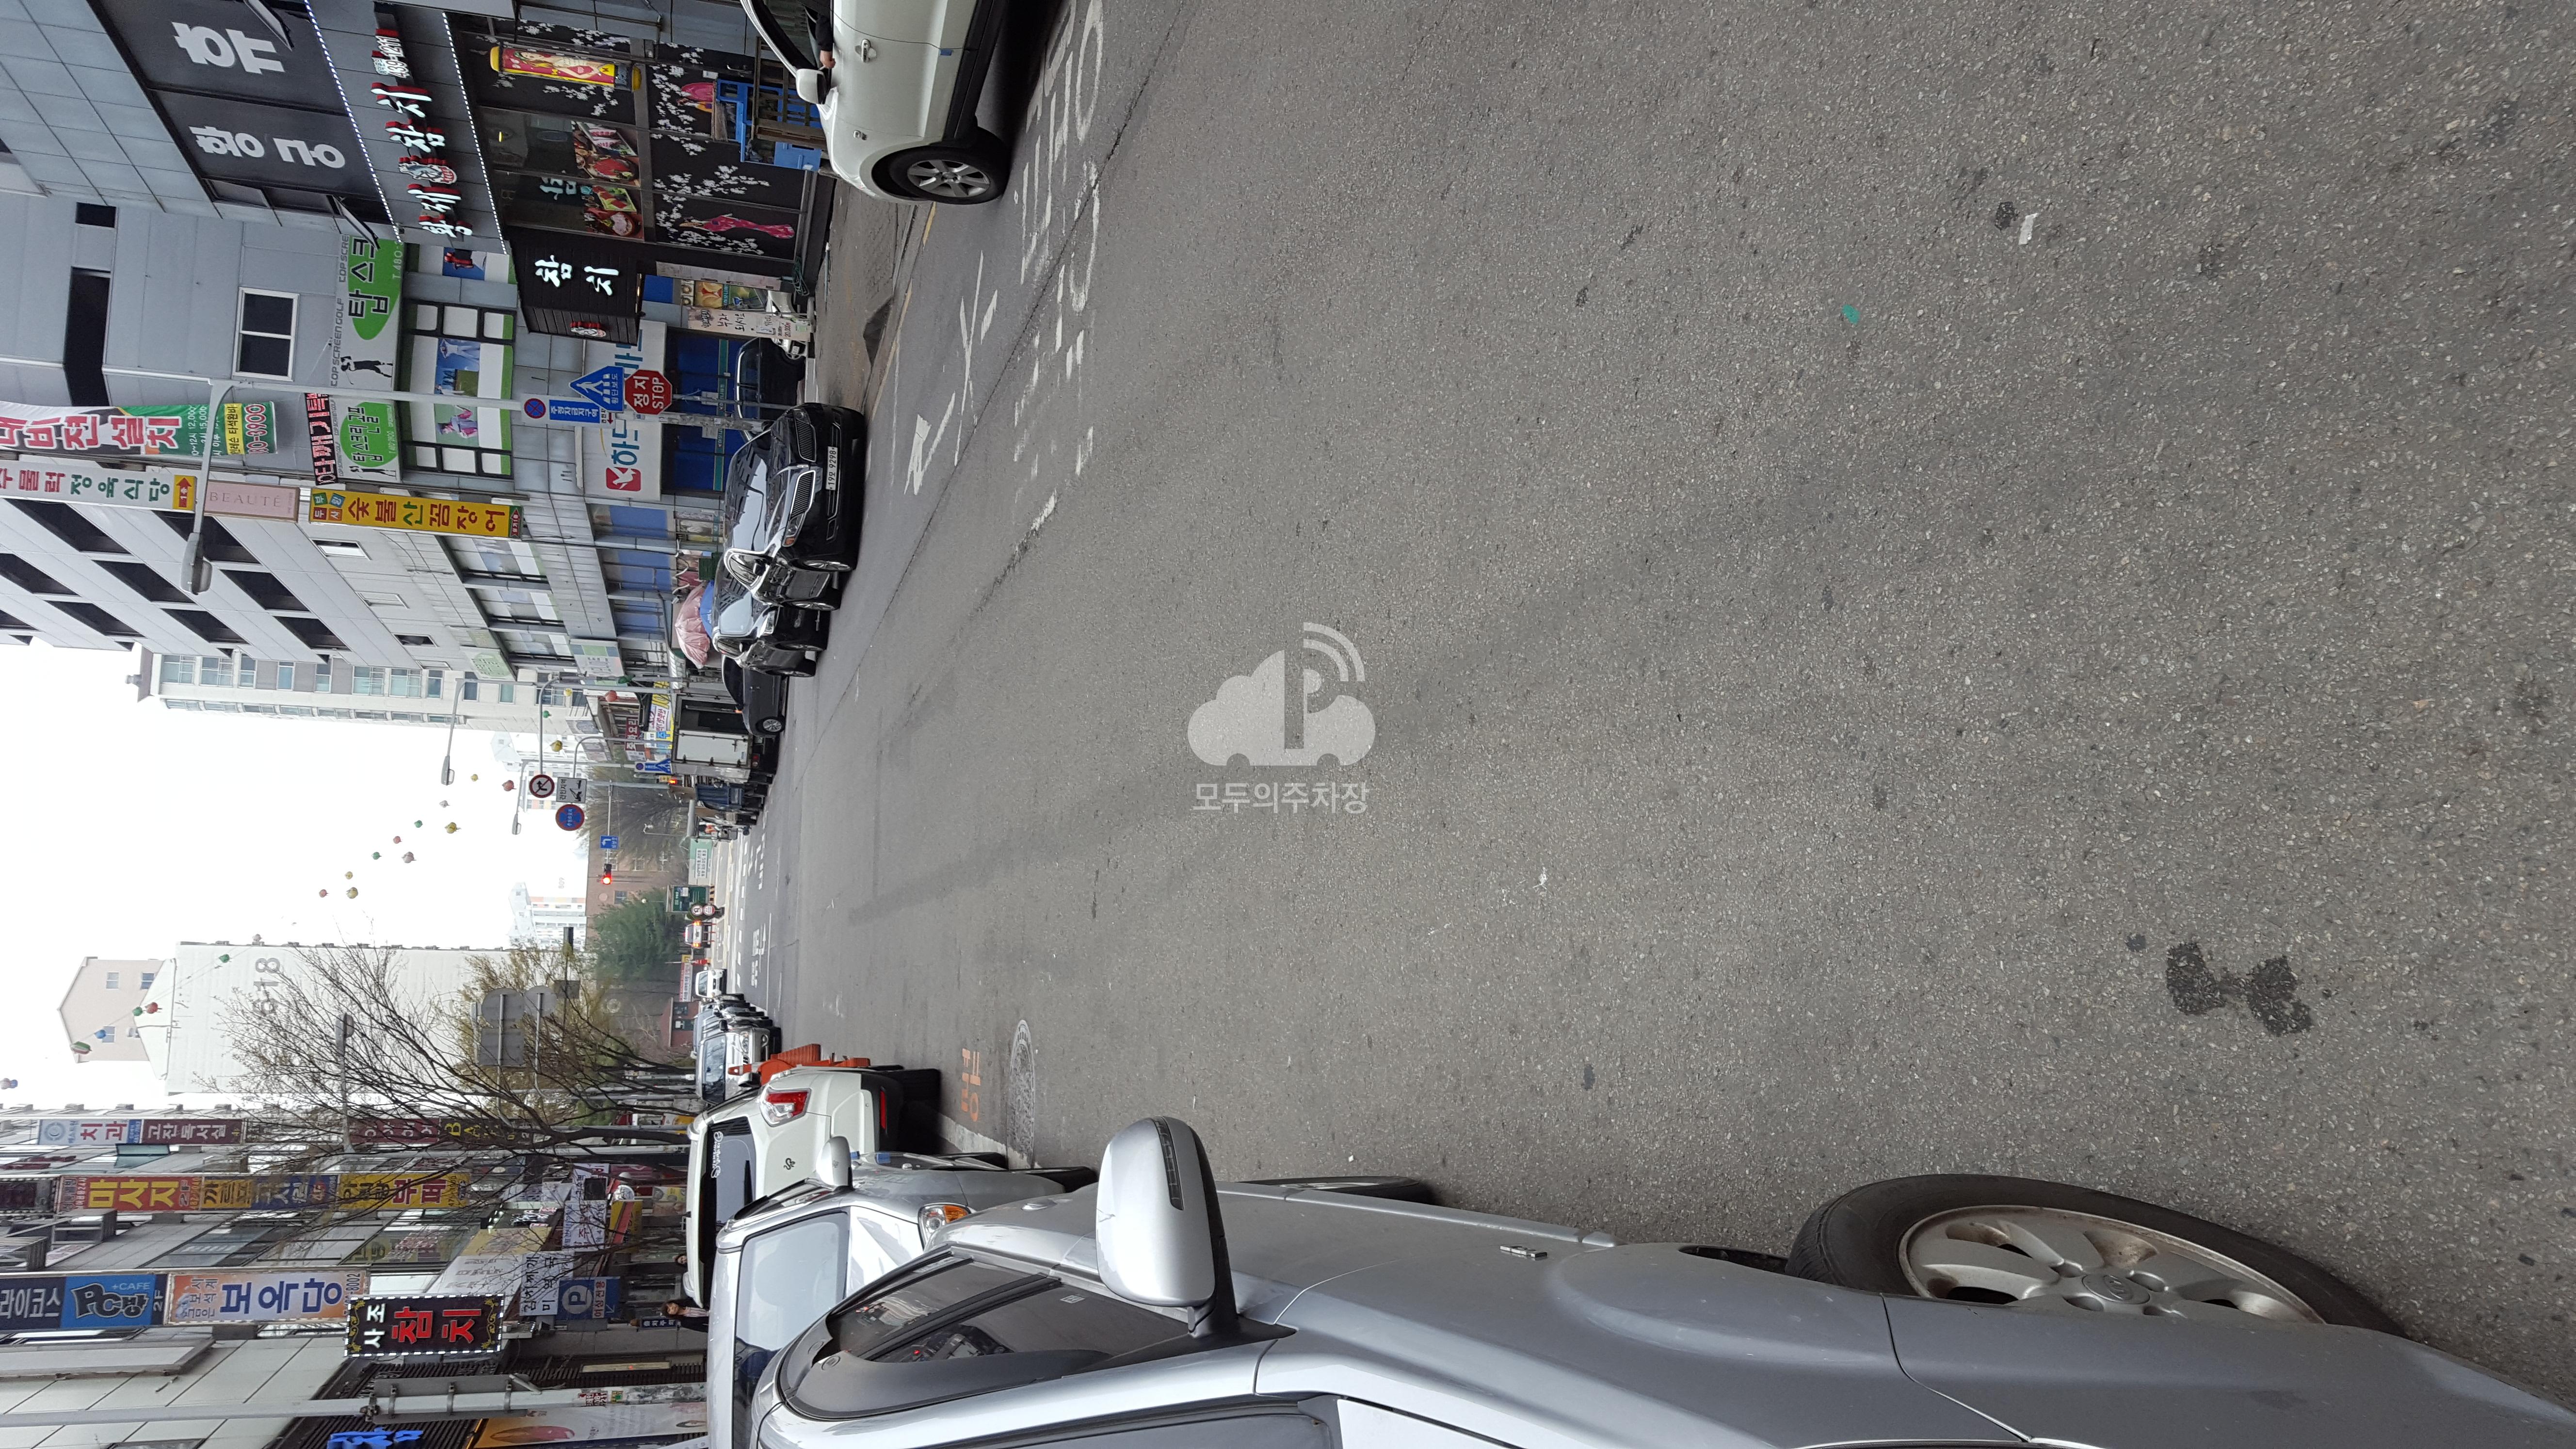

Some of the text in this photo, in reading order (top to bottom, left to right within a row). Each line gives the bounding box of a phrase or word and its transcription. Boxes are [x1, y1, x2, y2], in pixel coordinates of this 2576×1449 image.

[171, 21, 286, 75] 휴
[375, 35, 410, 78] 439-1211
[188, 126, 346, 168] 황궁
[370, 87, 473, 238] 황제 참치
[534, 254, 620, 296] 참치
[334, 297, 344, 325] GOLF
[348, 289, 389, 318] 탑
[332, 325, 342, 366] SCREEN
[633, 376, 650, 407] 정지
[652, 377, 664, 409] STOP
[226, 407, 238, 434] 타석완비
[80, 1121, 127, 1141] 치과
[148, 1123, 227, 1141] 고잔독서실
[88, 1179, 179, 1208] 마사지
[153, 1289, 164, 1312] 2F
[220, 1277, 342, 1314] 보옥당
[364, 1303, 386, 1348] 사조
[391, 1306, 482, 1344] 참치
